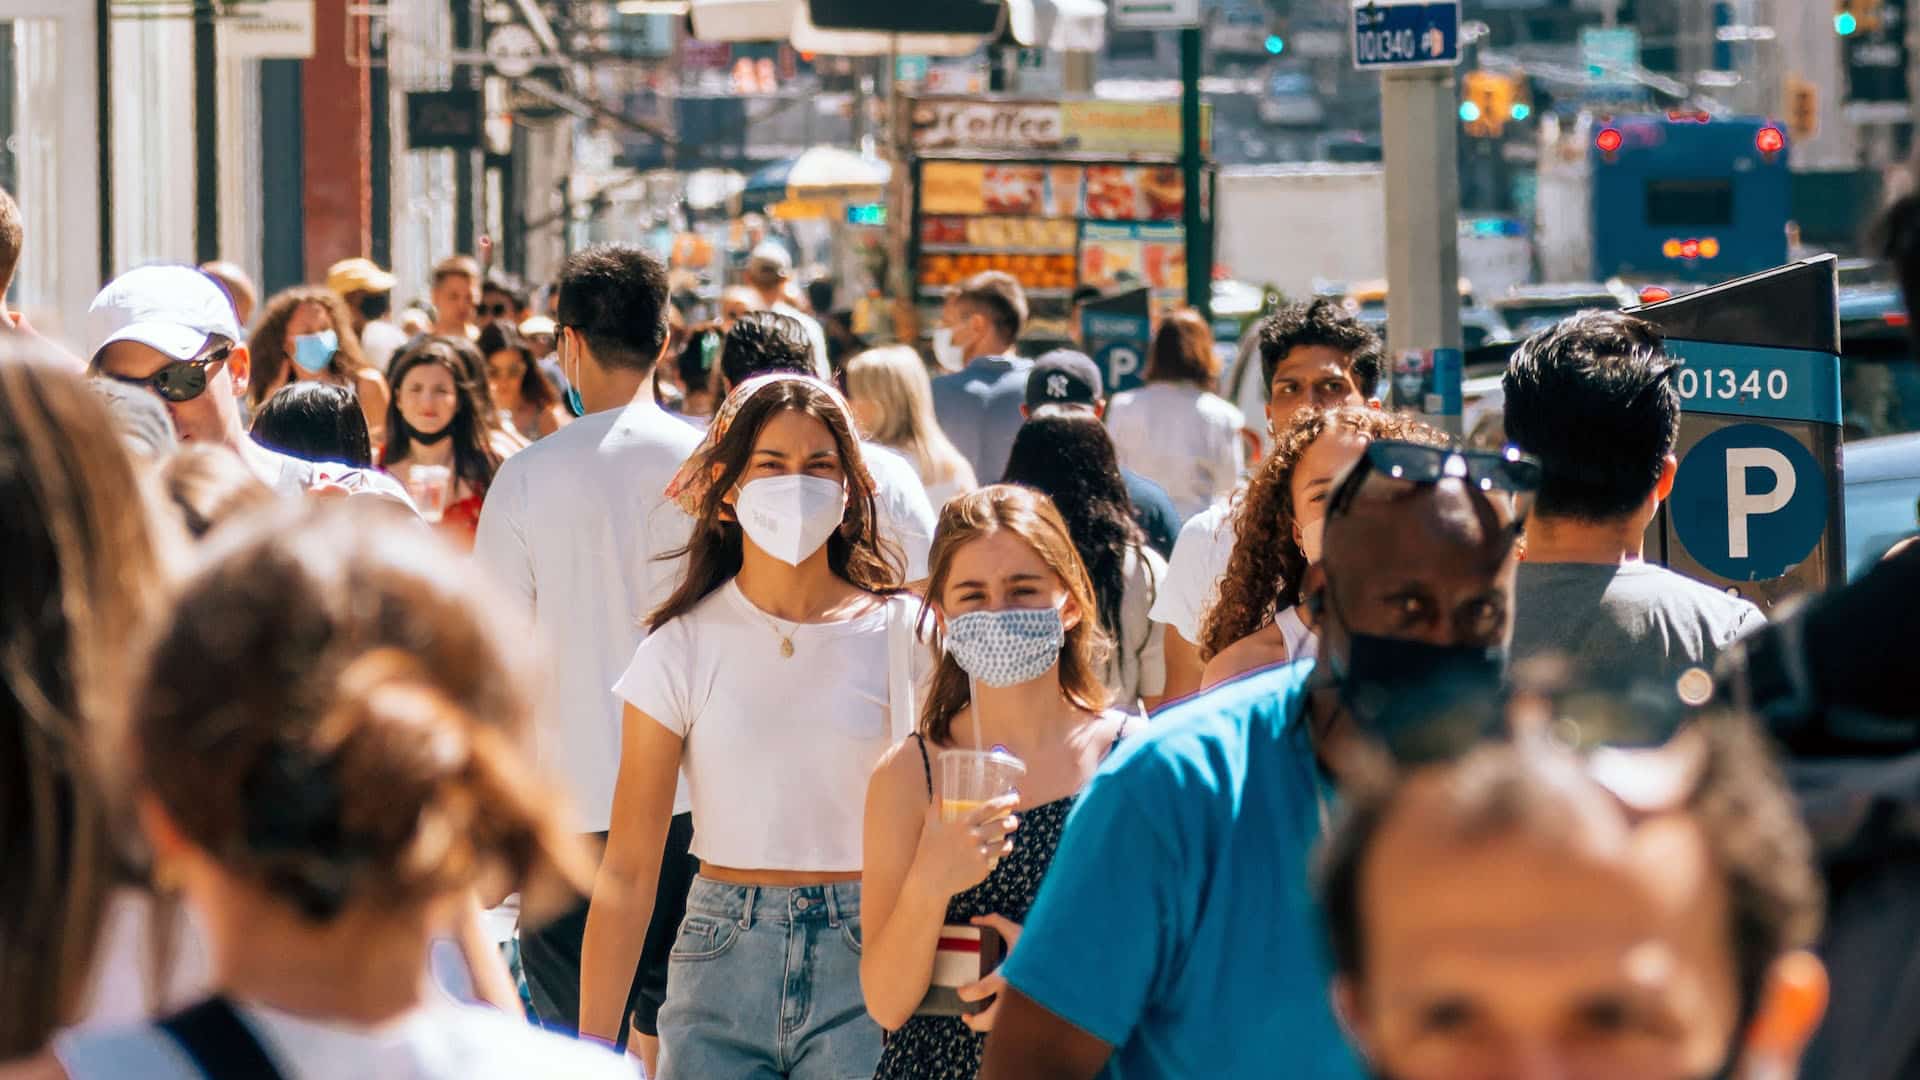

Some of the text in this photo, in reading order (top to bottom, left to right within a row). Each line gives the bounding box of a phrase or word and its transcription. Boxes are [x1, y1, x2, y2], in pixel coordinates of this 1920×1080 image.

[1358, 30, 1415, 61] 101340
[942, 106, 1058, 145] Coffee
[1109, 348, 1138, 388] P
[1677, 368, 1788, 400] 01340
[1726, 447, 1797, 558] P
